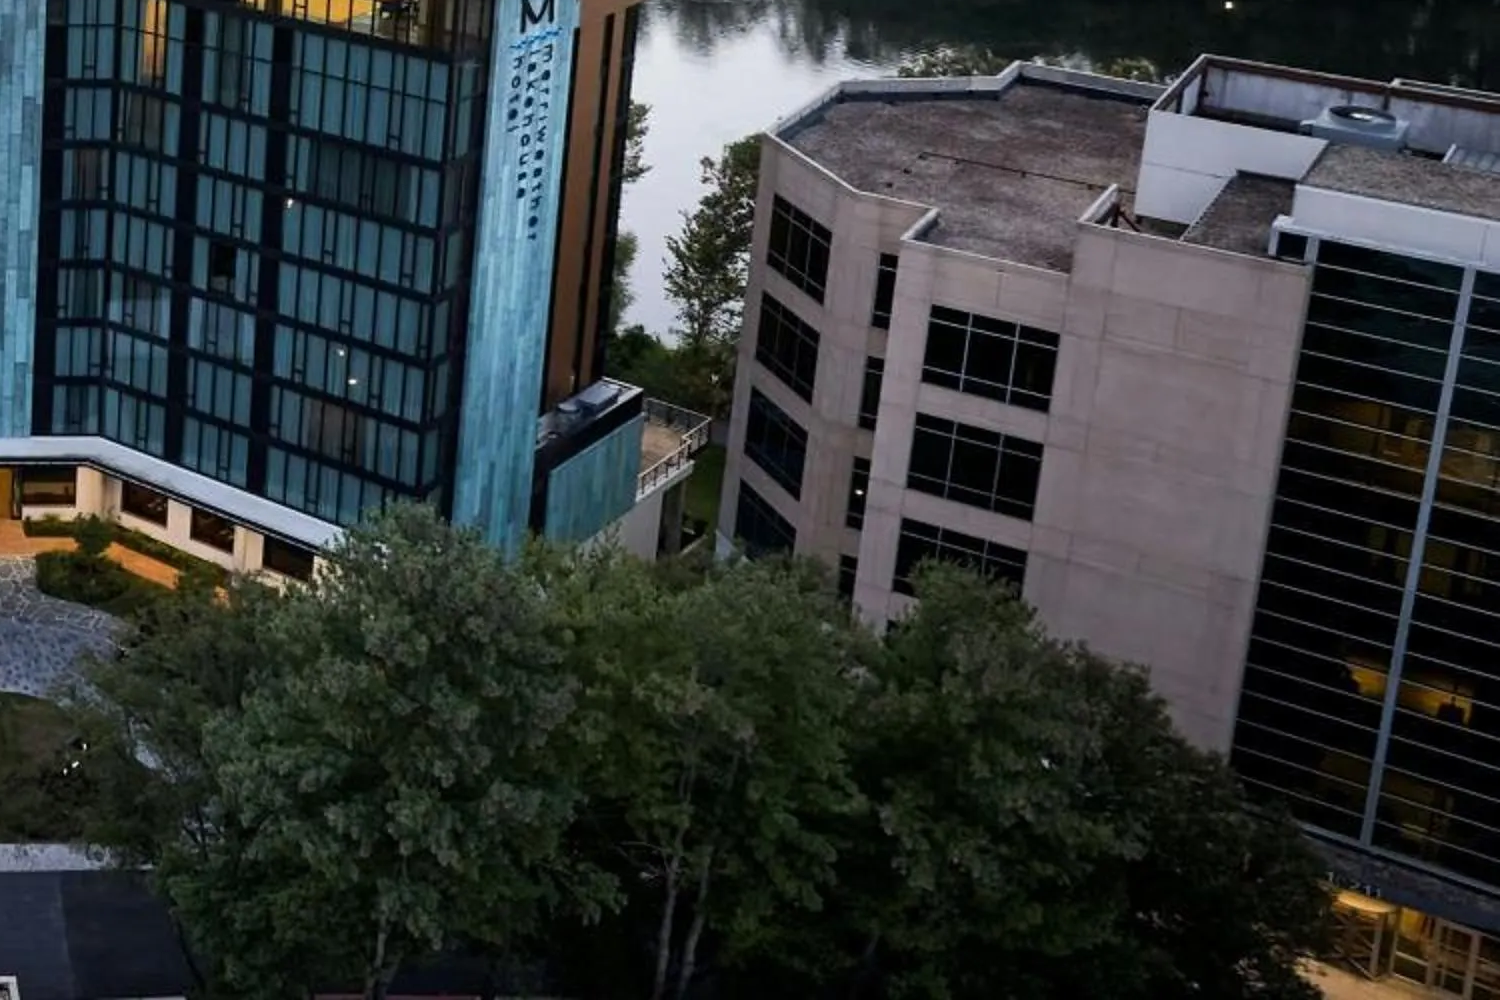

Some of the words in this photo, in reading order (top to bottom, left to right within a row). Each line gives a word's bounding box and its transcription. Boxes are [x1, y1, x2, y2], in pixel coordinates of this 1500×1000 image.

[506, 55, 525, 132] hotel
[516, 49, 541, 199] lakehouse
[527, 43, 553, 240] merriweather
